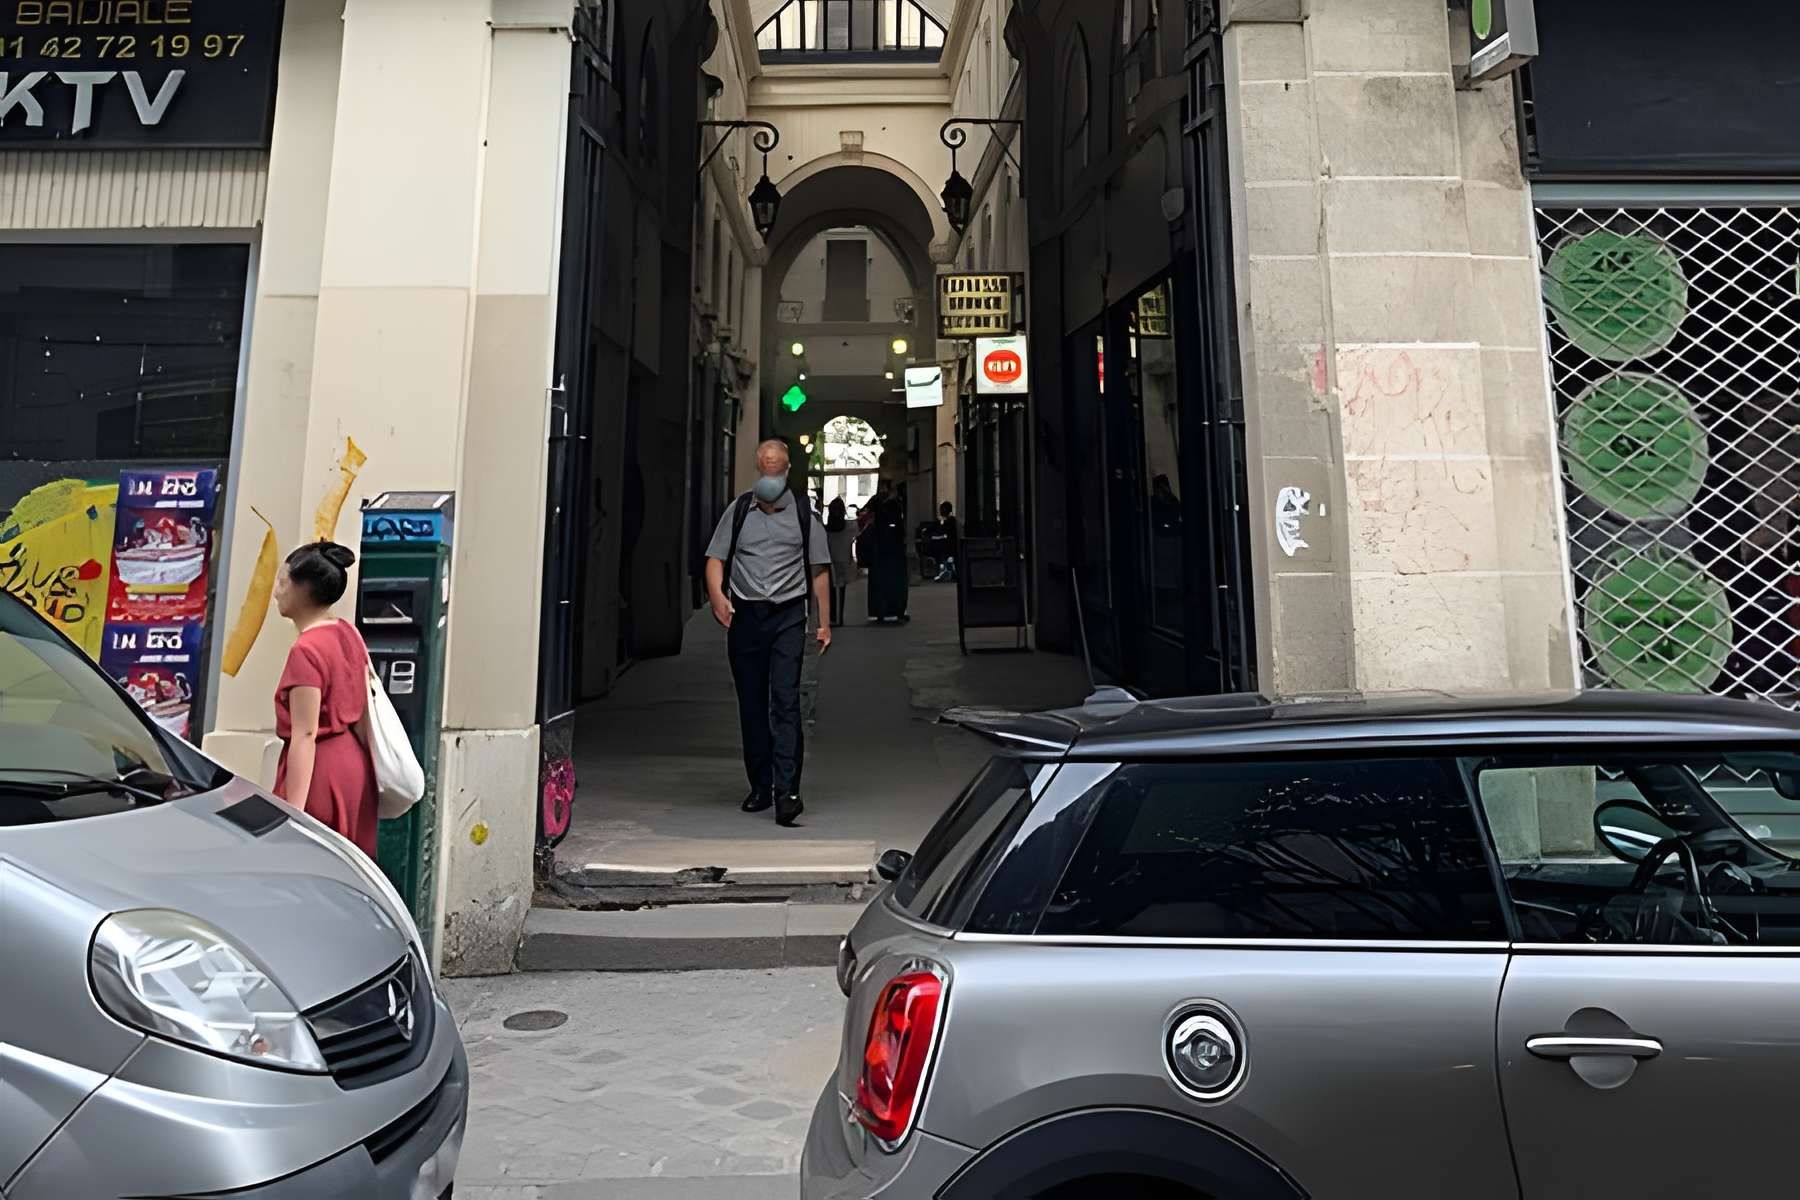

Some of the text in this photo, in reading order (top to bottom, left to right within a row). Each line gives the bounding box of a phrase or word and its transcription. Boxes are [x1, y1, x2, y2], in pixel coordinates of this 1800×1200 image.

[96, 36, 136, 59] 72
[151, 34, 191, 58] 19
[203, 34, 245, 58] 97
[0, 70, 186, 135] KTV
